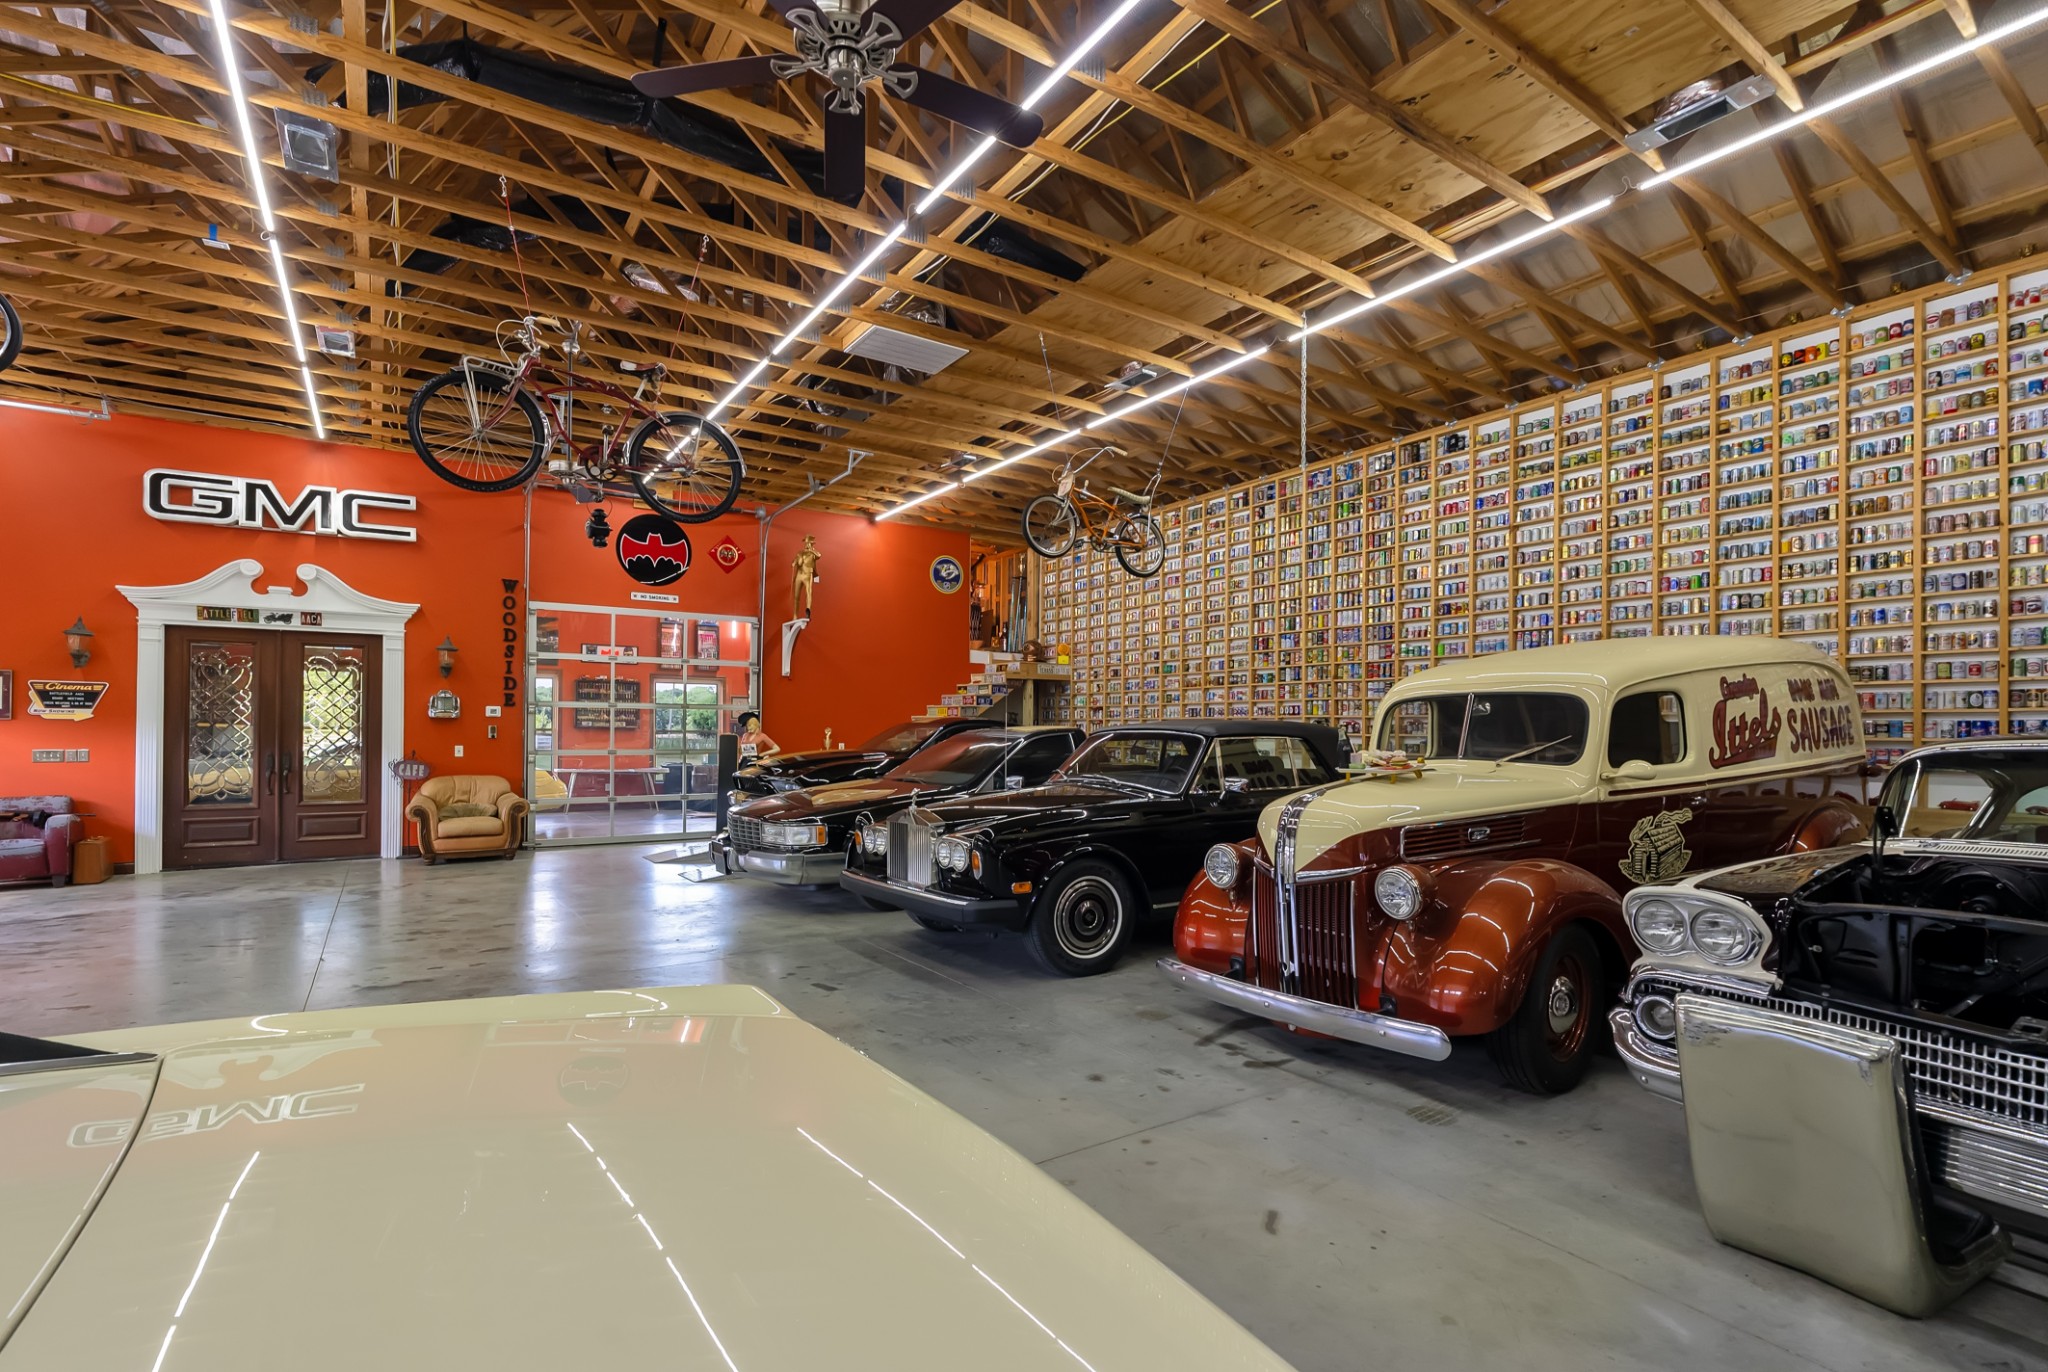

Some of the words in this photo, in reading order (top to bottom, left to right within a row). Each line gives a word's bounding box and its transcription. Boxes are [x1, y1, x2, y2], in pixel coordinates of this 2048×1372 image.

[143, 468, 416, 542] GMC
[301, 612, 322, 625] AACA
[502, 579, 518, 706] WOODSIDE
[45, 682, 92, 690] Cinema
[1787, 705, 1855, 753] SAUSAGE
[398, 763, 425, 777] CAFE
